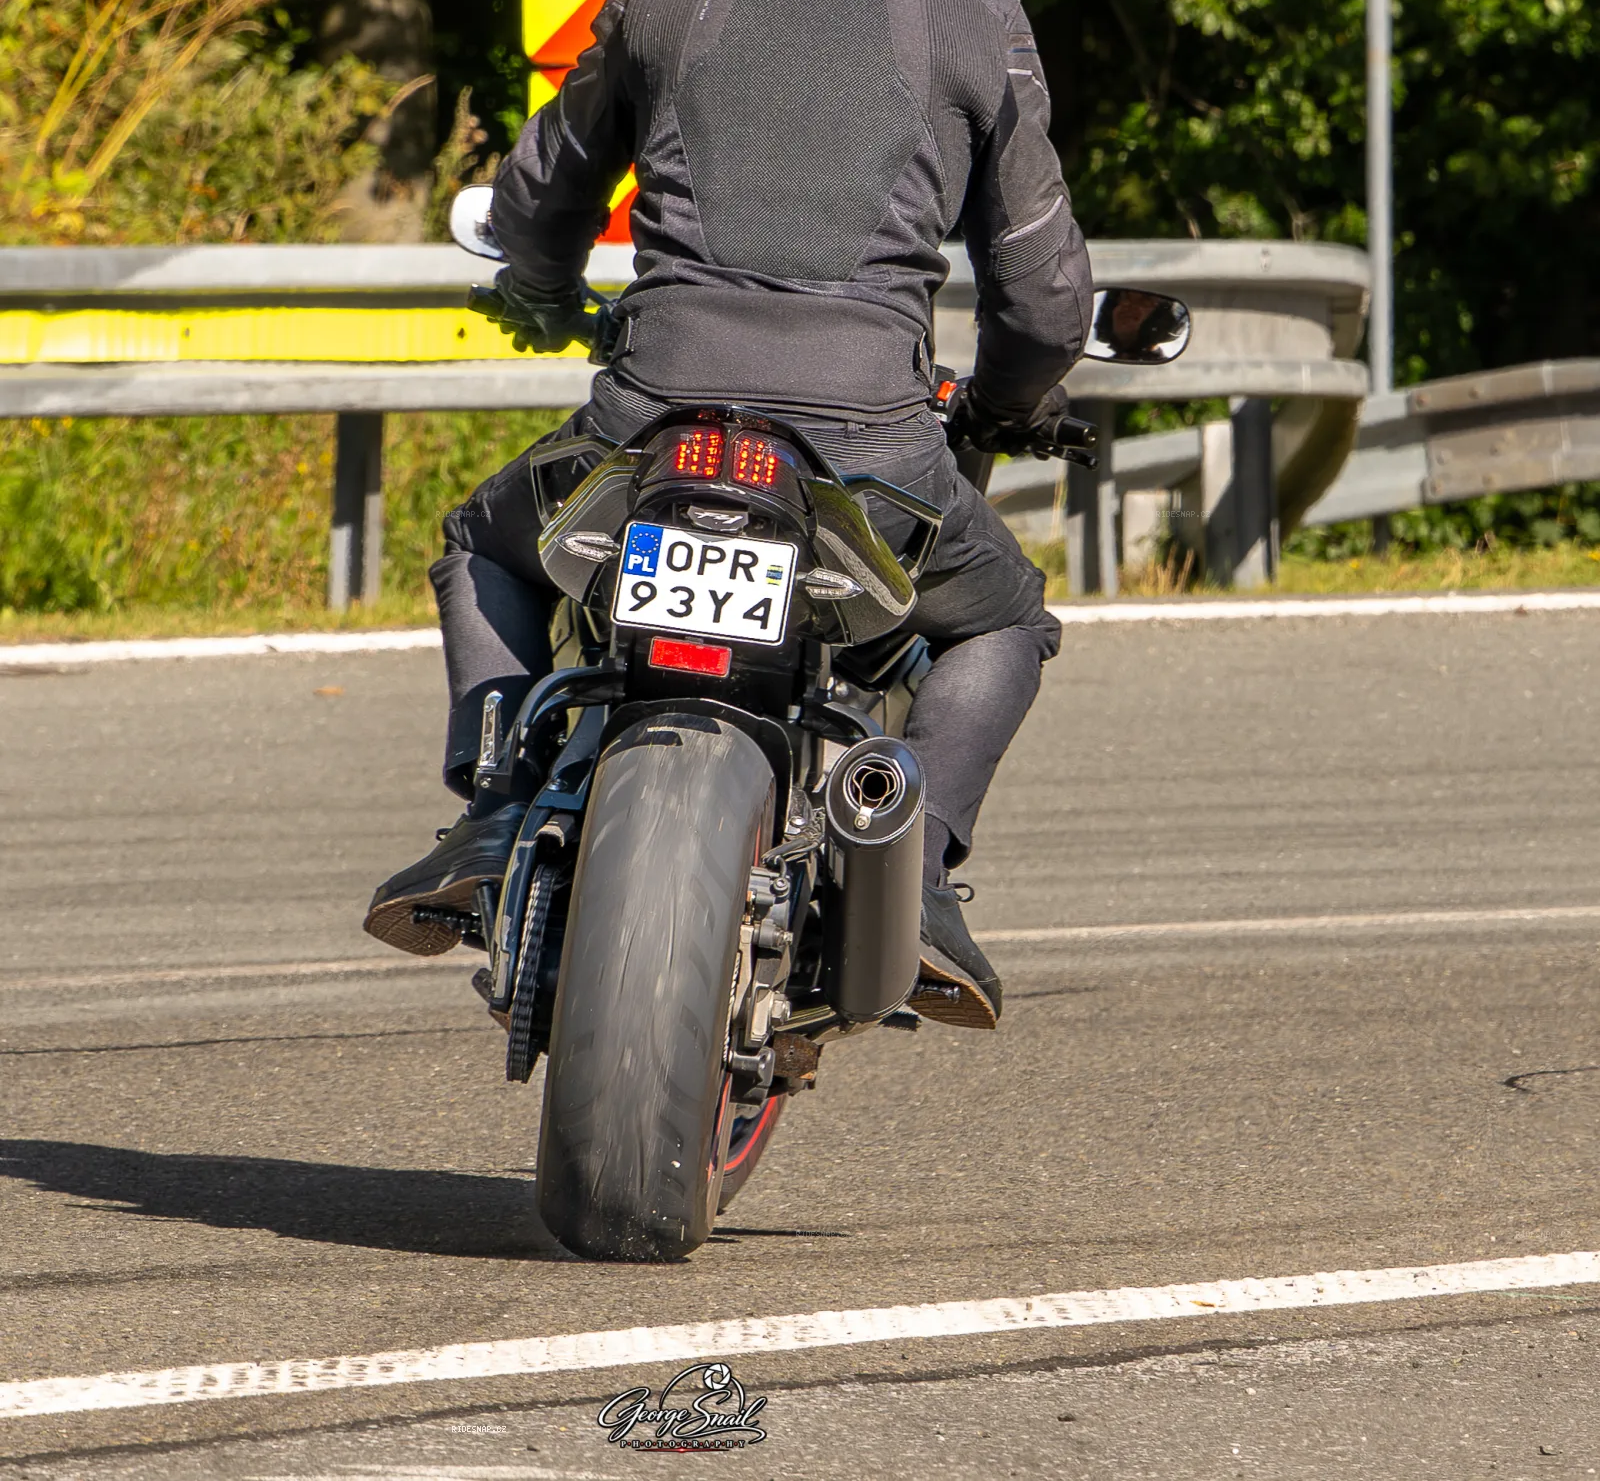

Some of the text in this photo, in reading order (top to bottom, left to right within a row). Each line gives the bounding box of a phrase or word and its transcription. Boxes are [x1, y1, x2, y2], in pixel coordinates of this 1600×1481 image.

[627, 541, 759, 583] PL OPR
[628, 580, 773, 630] 93Y4
